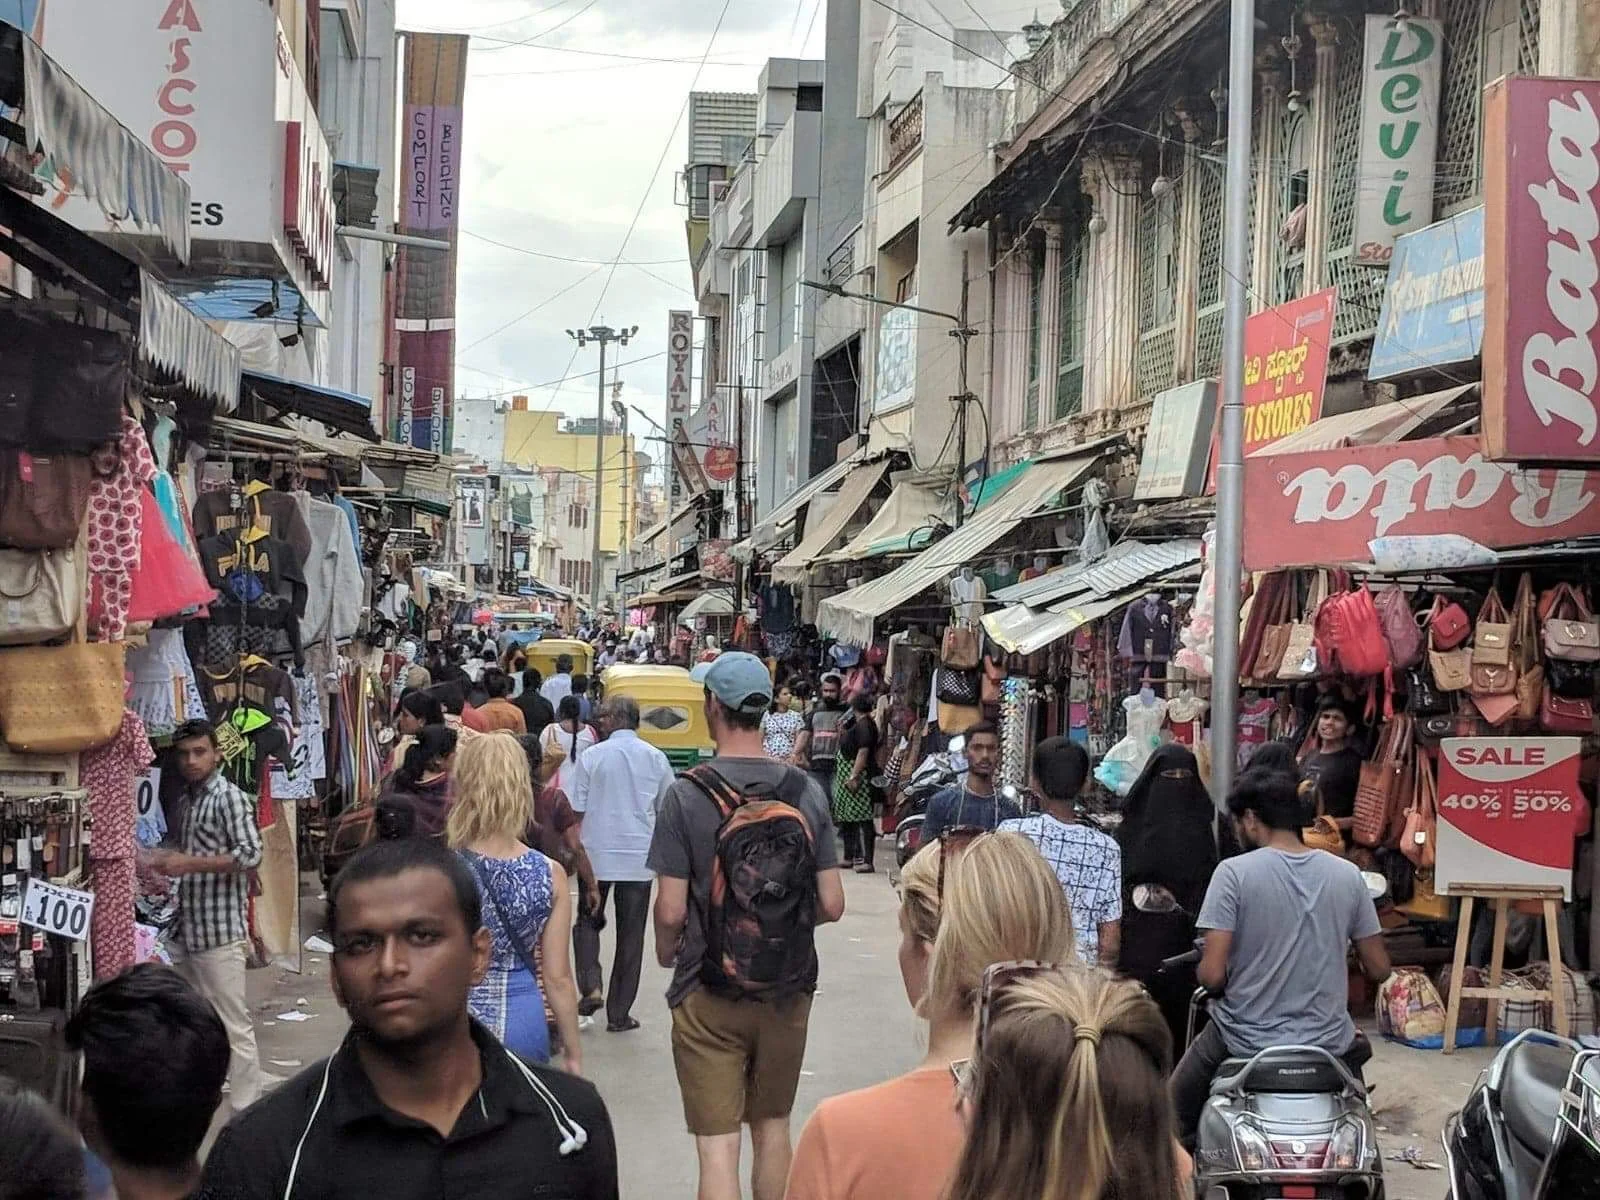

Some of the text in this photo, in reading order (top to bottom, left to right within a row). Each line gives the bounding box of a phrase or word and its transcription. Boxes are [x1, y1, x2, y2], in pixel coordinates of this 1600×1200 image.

[1375, 20, 1435, 225] Devi
[412, 112, 427, 217] COMFORT
[1522, 87, 1600, 445] Bata
[671, 313, 690, 412] ROYAL
[1254, 391, 1313, 441] STORES
[1281, 453, 1597, 538] Bata
[1455, 747, 1546, 765] SALE
[1441, 794, 1503, 809] 40%
[1513, 796, 1572, 811] 50%
[36, 895, 86, 934] 100
